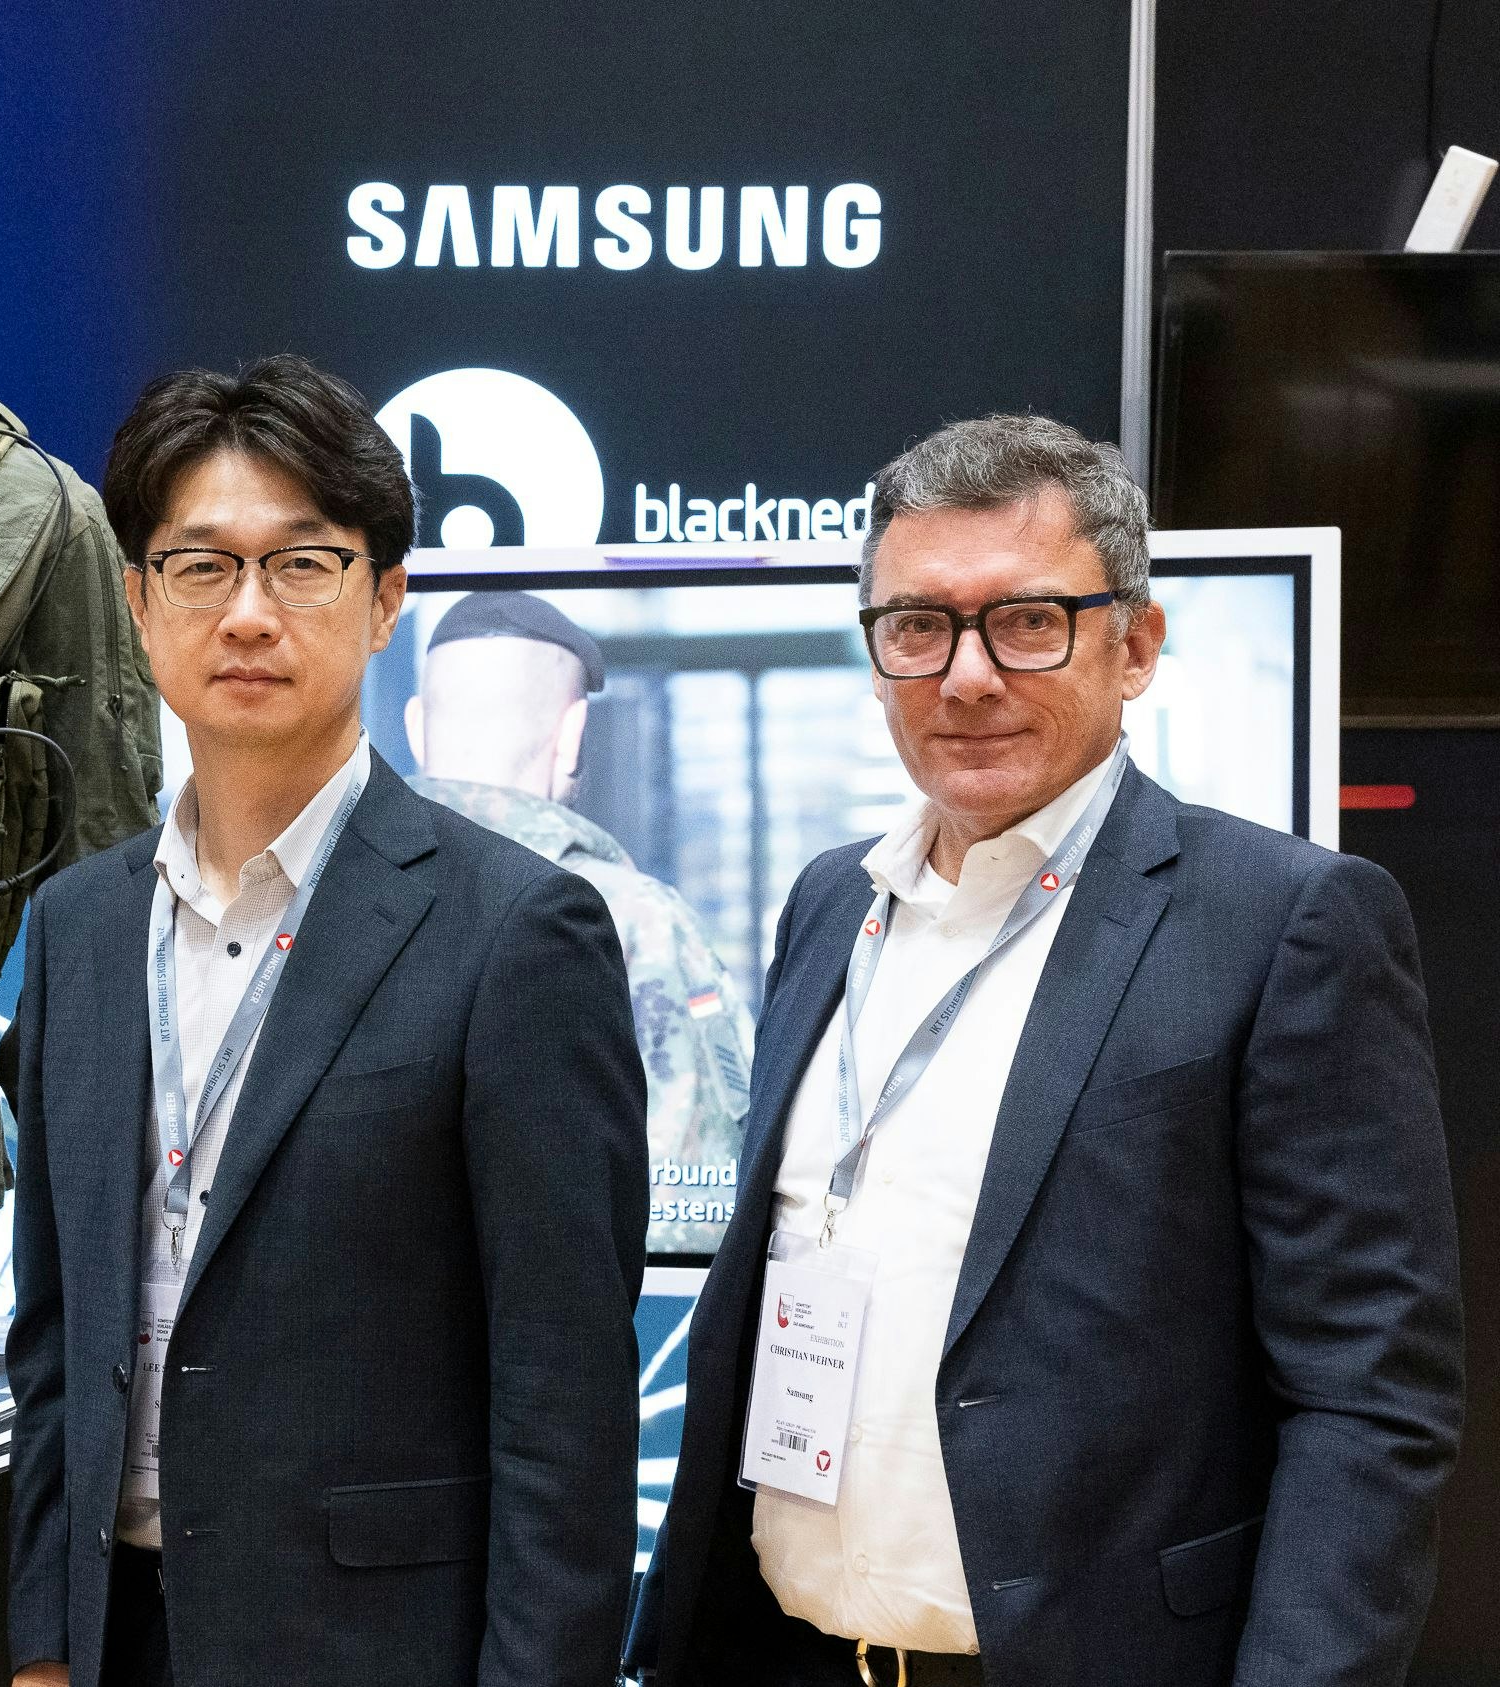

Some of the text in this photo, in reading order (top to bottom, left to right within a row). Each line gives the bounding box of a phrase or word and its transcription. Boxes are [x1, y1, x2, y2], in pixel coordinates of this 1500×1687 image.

[345, 181, 882, 271] SAMSUNG
[634, 482, 876, 544] blackned
[308, 796, 358, 889] SICHERHEITSKONFERENZ
[1056, 825, 1094, 874] UNSER HEER
[155, 927, 171, 1043] IKT SICHERHEITSKONFERENZ
[249, 953, 282, 1004] UNSER HEER
[852, 940, 874, 990] UNSER HEER
[929, 1019, 945, 1035] IKT
[222, 1047, 234, 1063] IKT
[884, 1074, 905, 1098] HEER
[165, 1092, 180, 1145] UNSER HEER
[770, 1343, 845, 1370] CHRISTIAN WEHNER
[810, 1334, 845, 1349] EXHIBITION
[142, 1362, 160, 1373] LEE
[786, 1386, 814, 1403] Samsung
